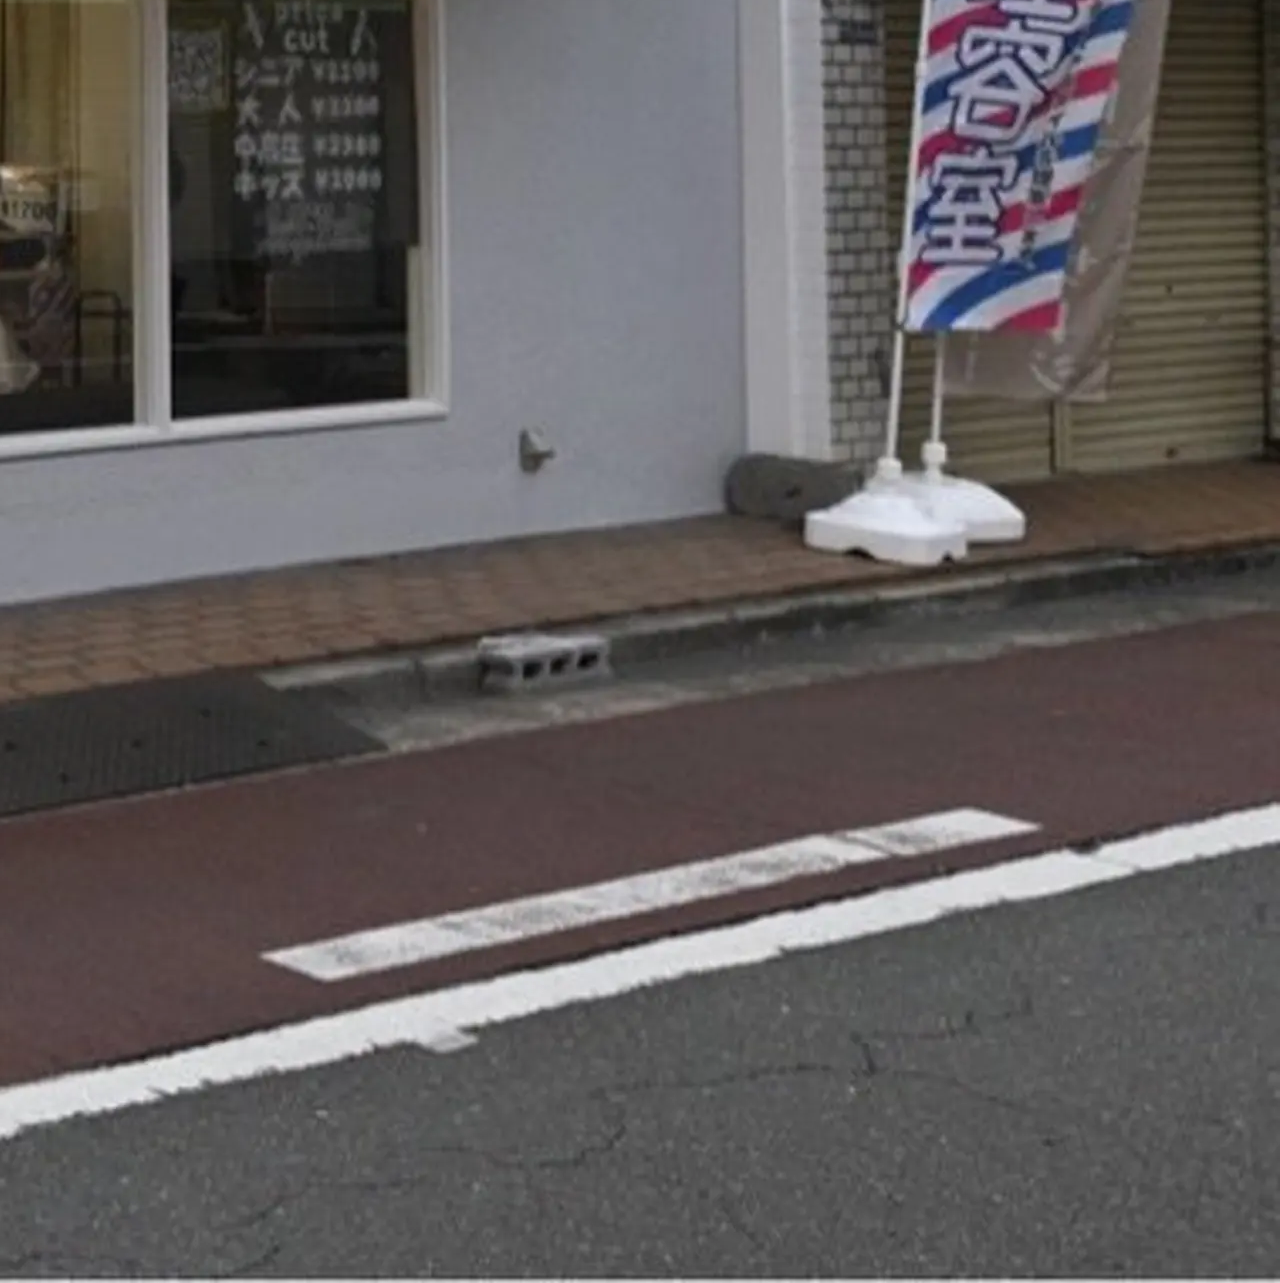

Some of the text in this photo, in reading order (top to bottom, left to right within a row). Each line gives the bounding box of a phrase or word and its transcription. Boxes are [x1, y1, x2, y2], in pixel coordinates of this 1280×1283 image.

[283, 23, 330, 55] cut
[234, 56, 305, 90] シニア
[235, 93, 303, 127] 大人
